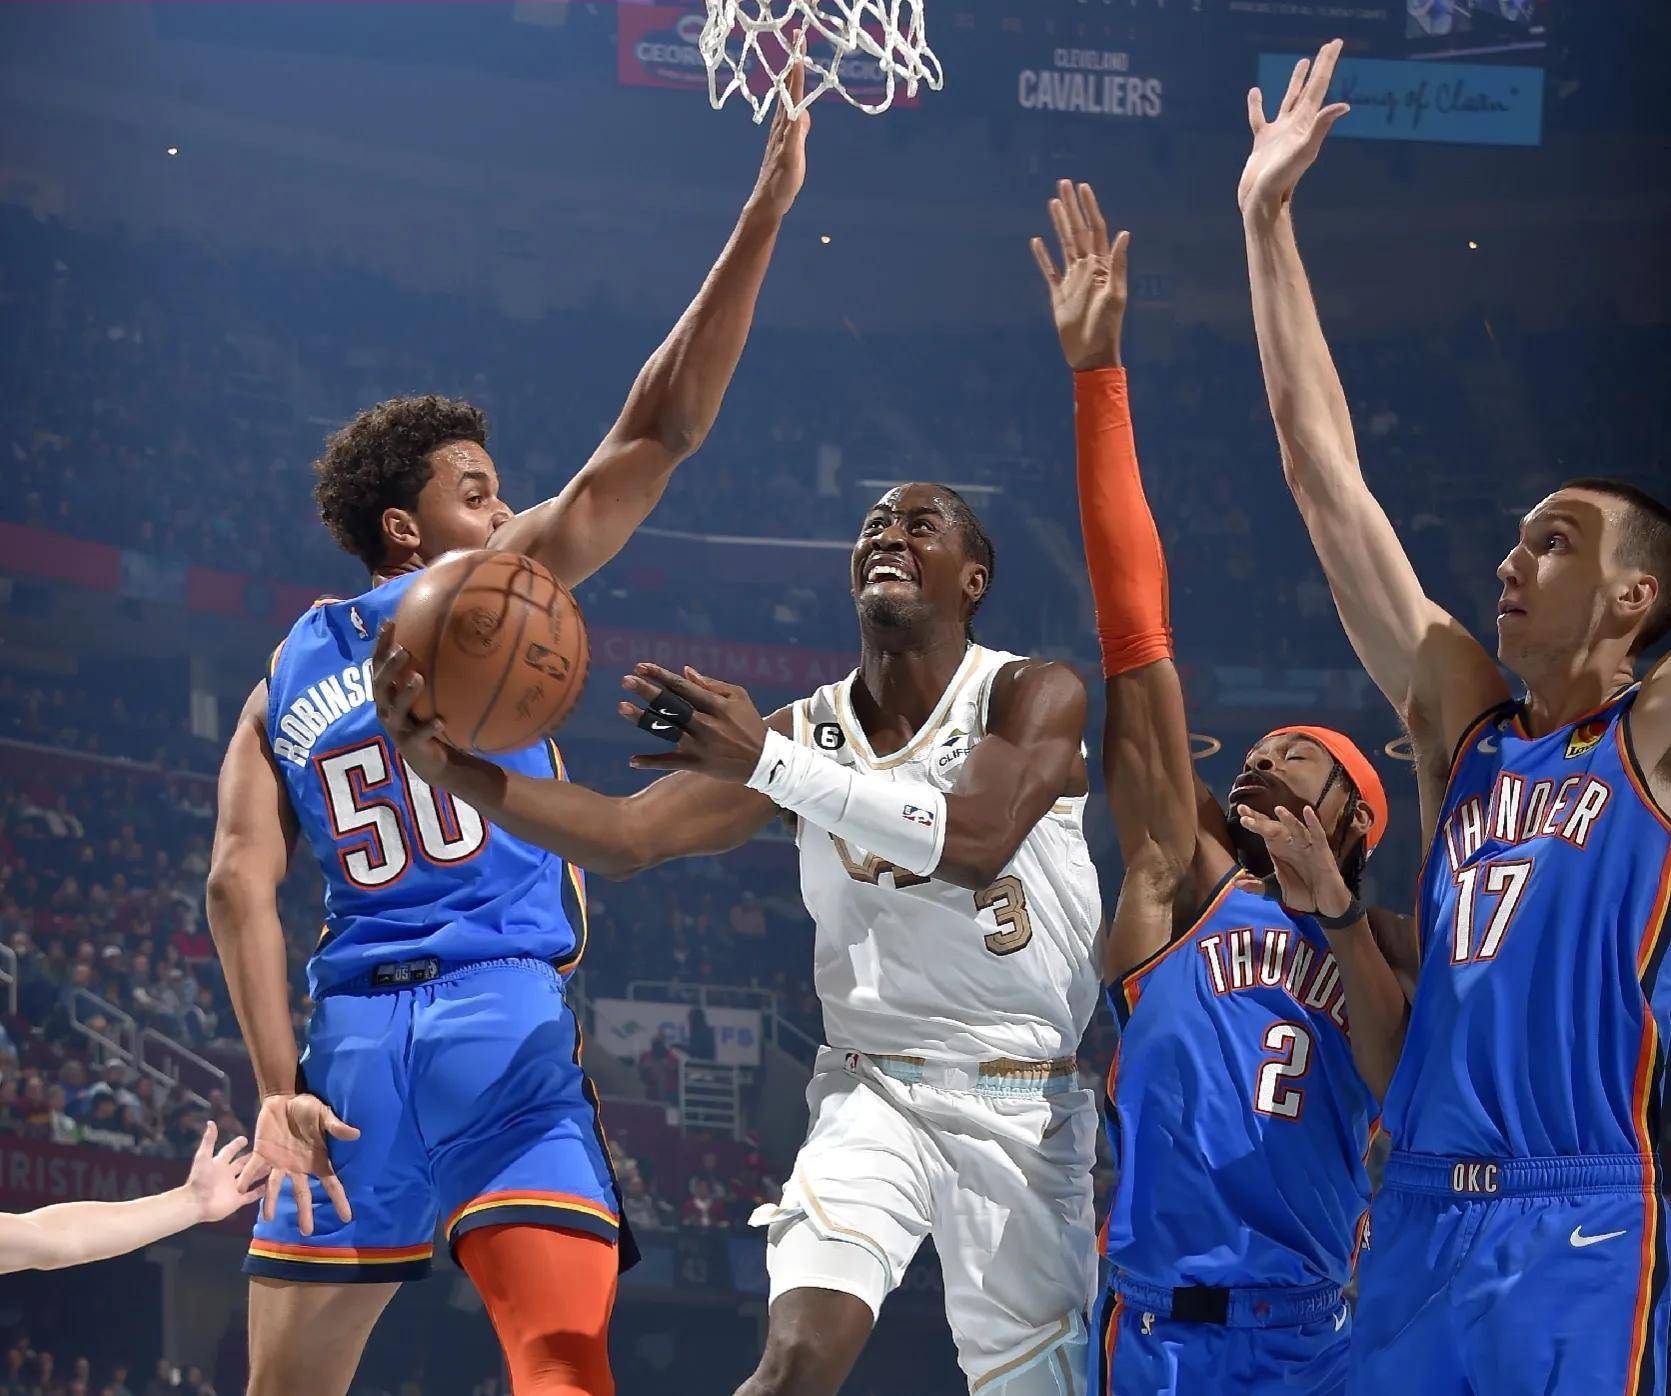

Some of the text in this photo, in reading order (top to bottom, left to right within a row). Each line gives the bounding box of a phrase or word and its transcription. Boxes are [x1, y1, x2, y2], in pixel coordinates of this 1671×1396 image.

[1054, 48, 1130, 72] CLEVELAND
[1018, 69, 1163, 117] CAVALIERS
[821, 730, 839, 748] 6
[312, 736, 490, 891] 50
[974, 874, 1034, 956] 3
[1451, 857, 1535, 965] 17
[1253, 1019, 1319, 1124] 2
[0, 1149, 164, 1200] RISTMAS
[1452, 1163, 1498, 1193] OKC
